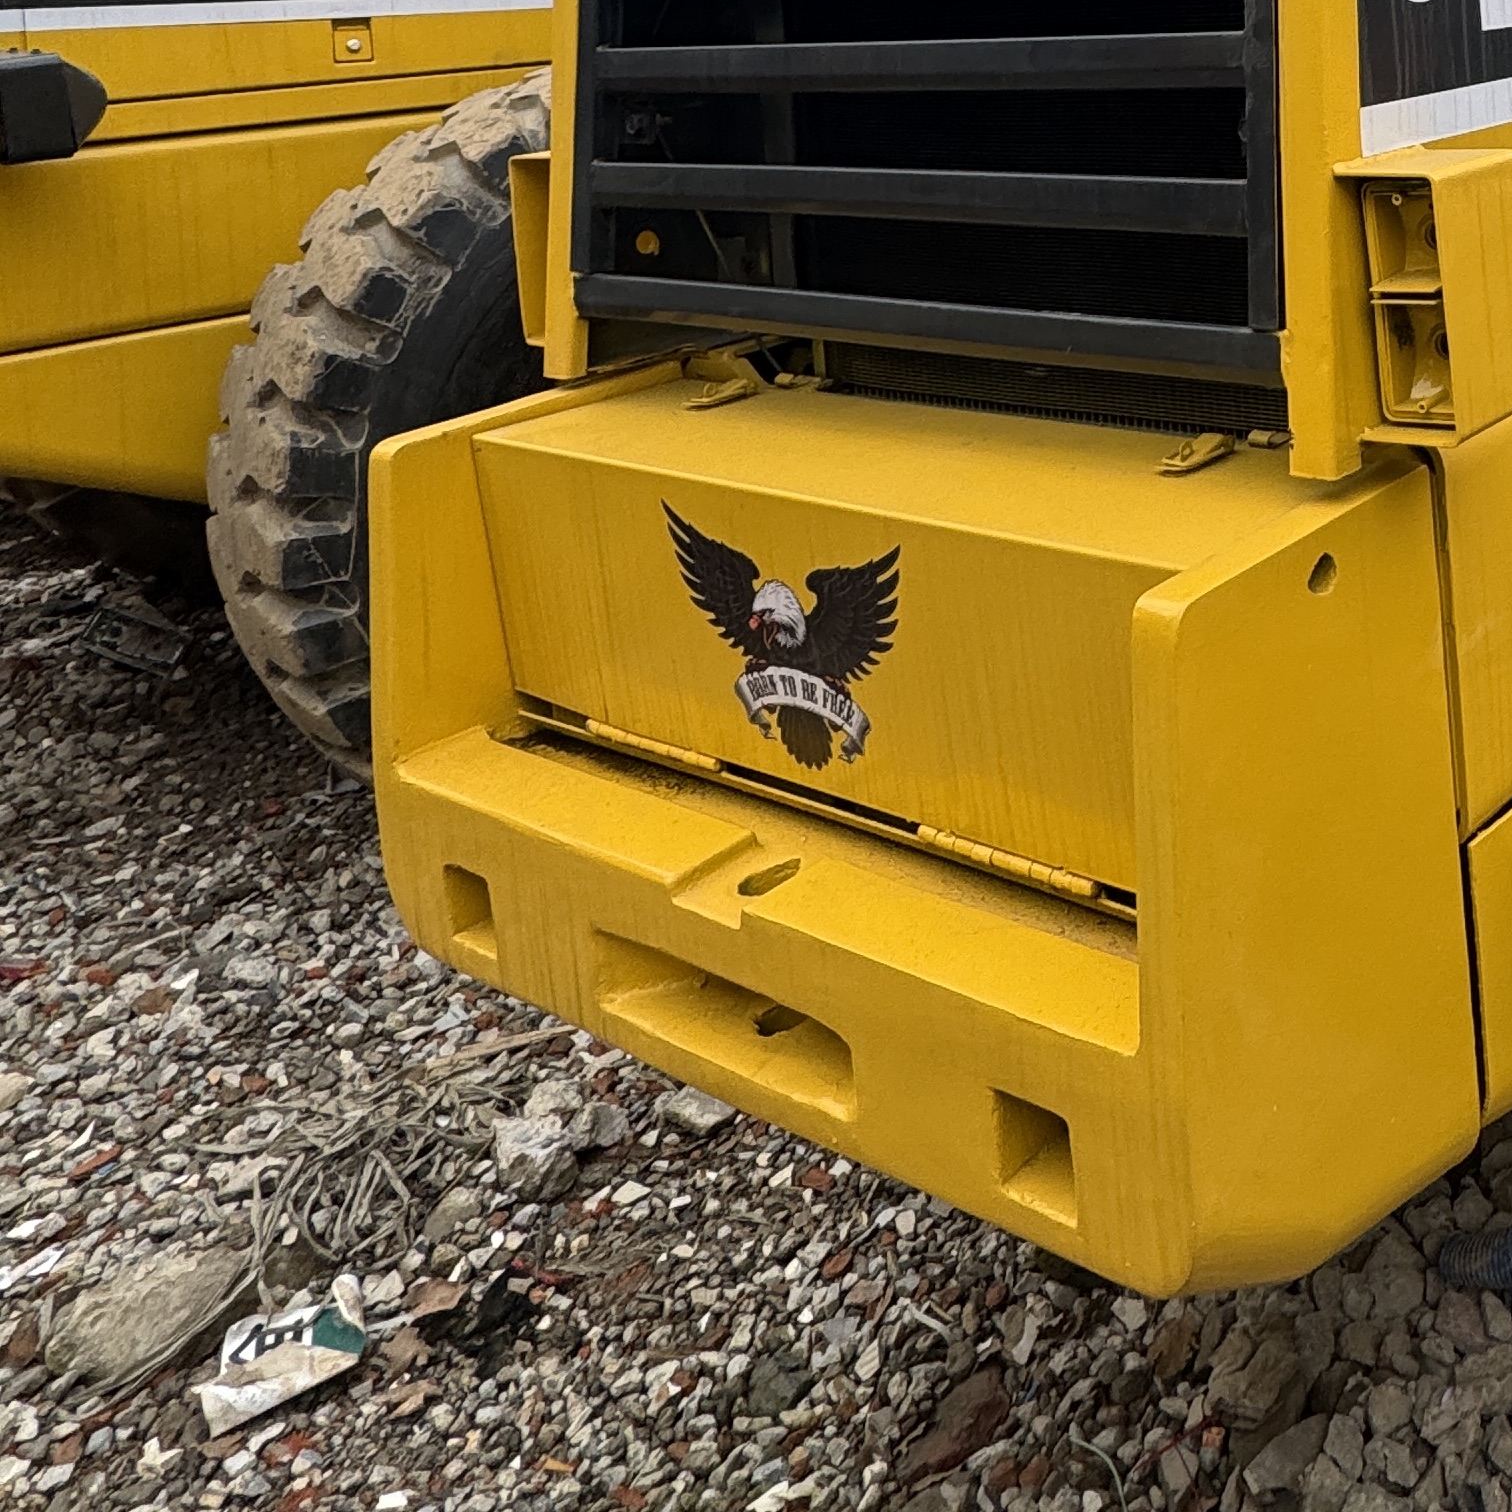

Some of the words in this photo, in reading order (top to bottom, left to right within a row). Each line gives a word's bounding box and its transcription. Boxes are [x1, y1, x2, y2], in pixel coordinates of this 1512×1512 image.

[746, 673, 779, 702] BORN
[779, 674, 798, 698] TO
[800, 678, 819, 705] BE
